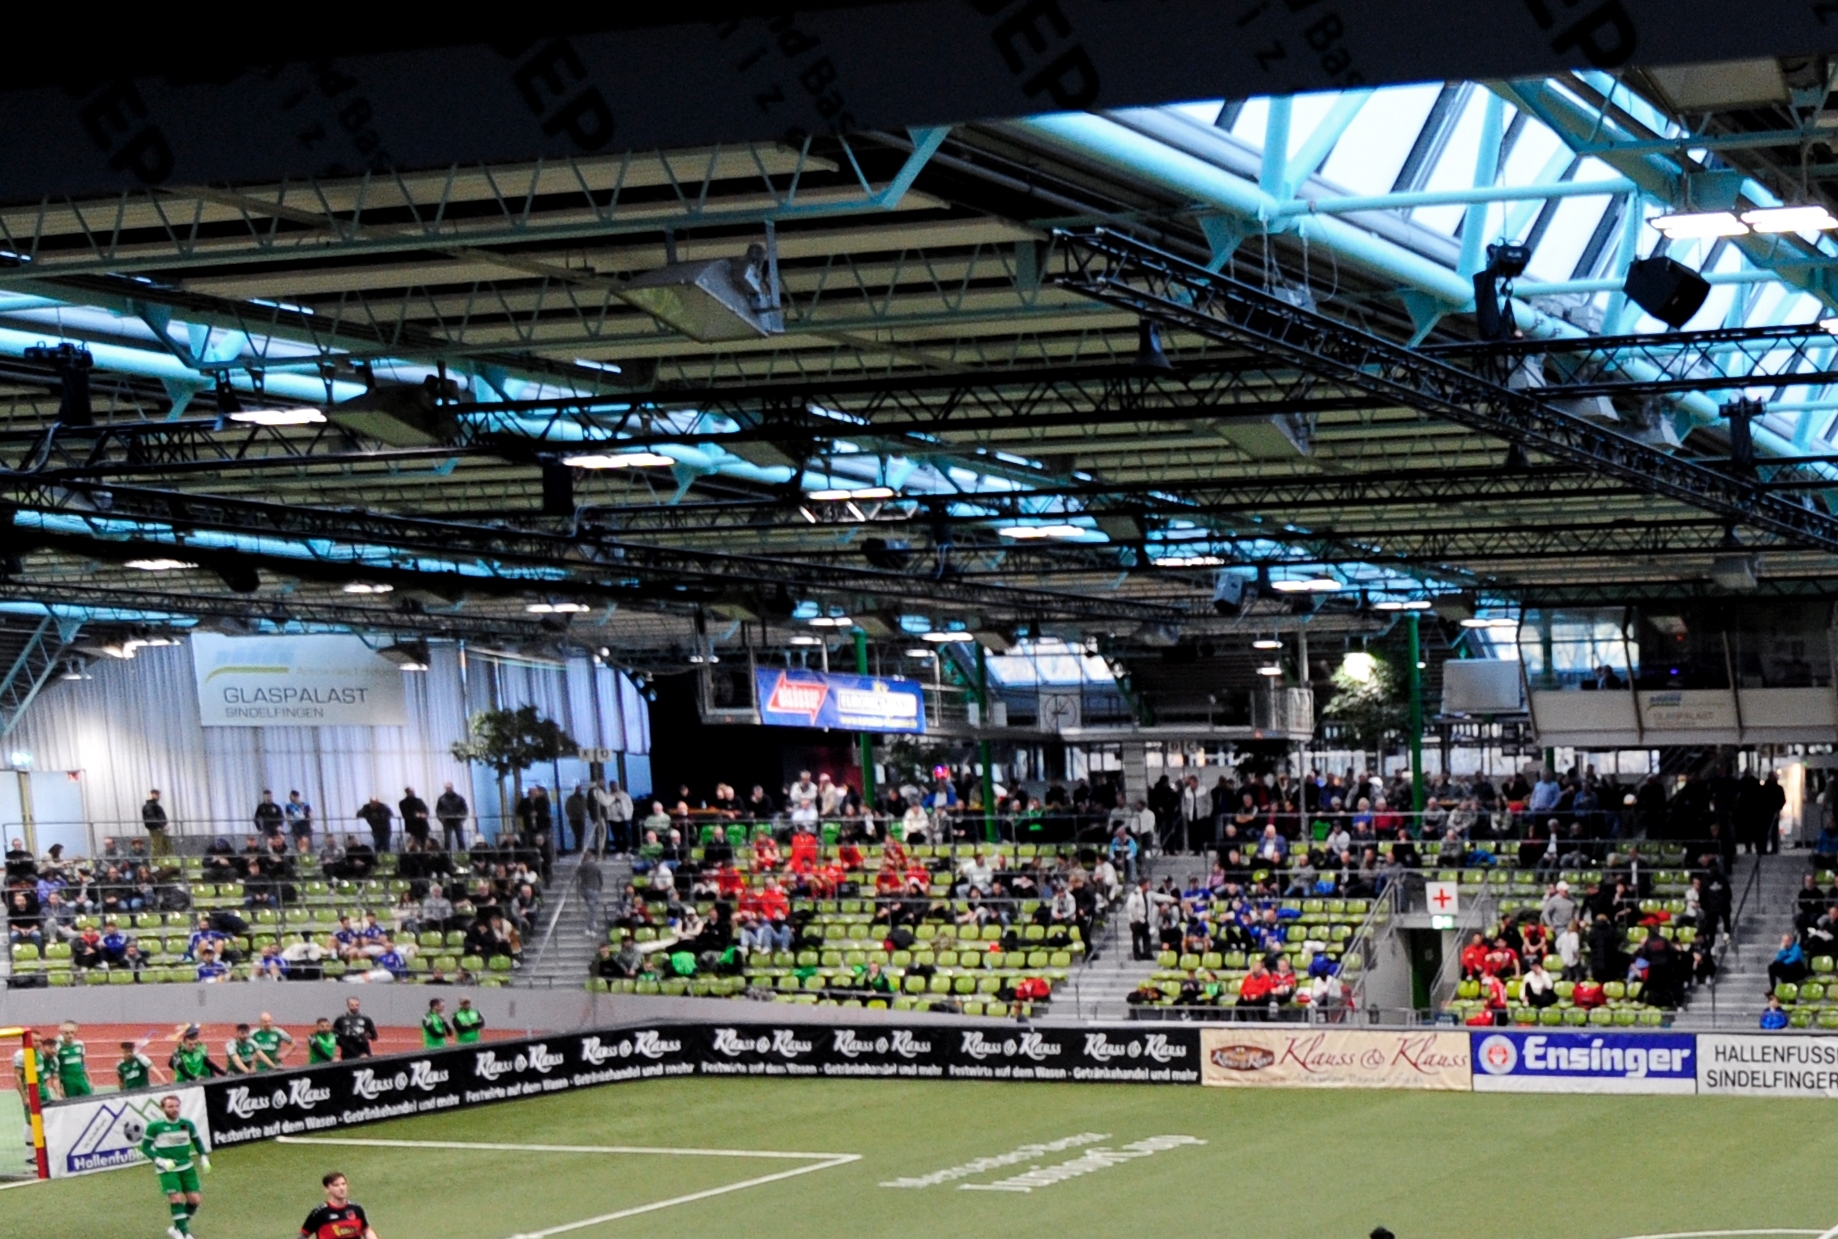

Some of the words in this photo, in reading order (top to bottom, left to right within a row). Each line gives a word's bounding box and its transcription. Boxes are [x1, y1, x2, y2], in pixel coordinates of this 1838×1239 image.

[223, 687, 368, 704] GLASPALAST
[225, 707, 324, 718] SINDELFINGEN
[581, 1036, 617, 1065] Klauss
[634, 1030, 681, 1058] Klauss
[714, 1028, 755, 1057] Klauss
[773, 1029, 812, 1058] Klauss
[833, 1029, 873, 1058] Klauss
[891, 1029, 931, 1058] Klauss
[961, 1031, 1002, 1059] Klauss
[1019, 1032, 1061, 1060] Klauss
[1084, 1033, 1125, 1062] Klauss
[1144, 1034, 1187, 1063] Klauss
[1278, 1033, 1355, 1073] Klauss
[1391, 1034, 1468, 1075] Klauss
[1522, 1036, 1691, 1078] Ensinger
[475, 1051, 512, 1081] Klauss
[528, 1044, 564, 1073] Klauss
[352, 1068, 393, 1099] Klauss
[410, 1060, 449, 1091] Klauss
[227, 1086, 270, 1119] Klauss
[289, 1077, 331, 1109] Klauss
